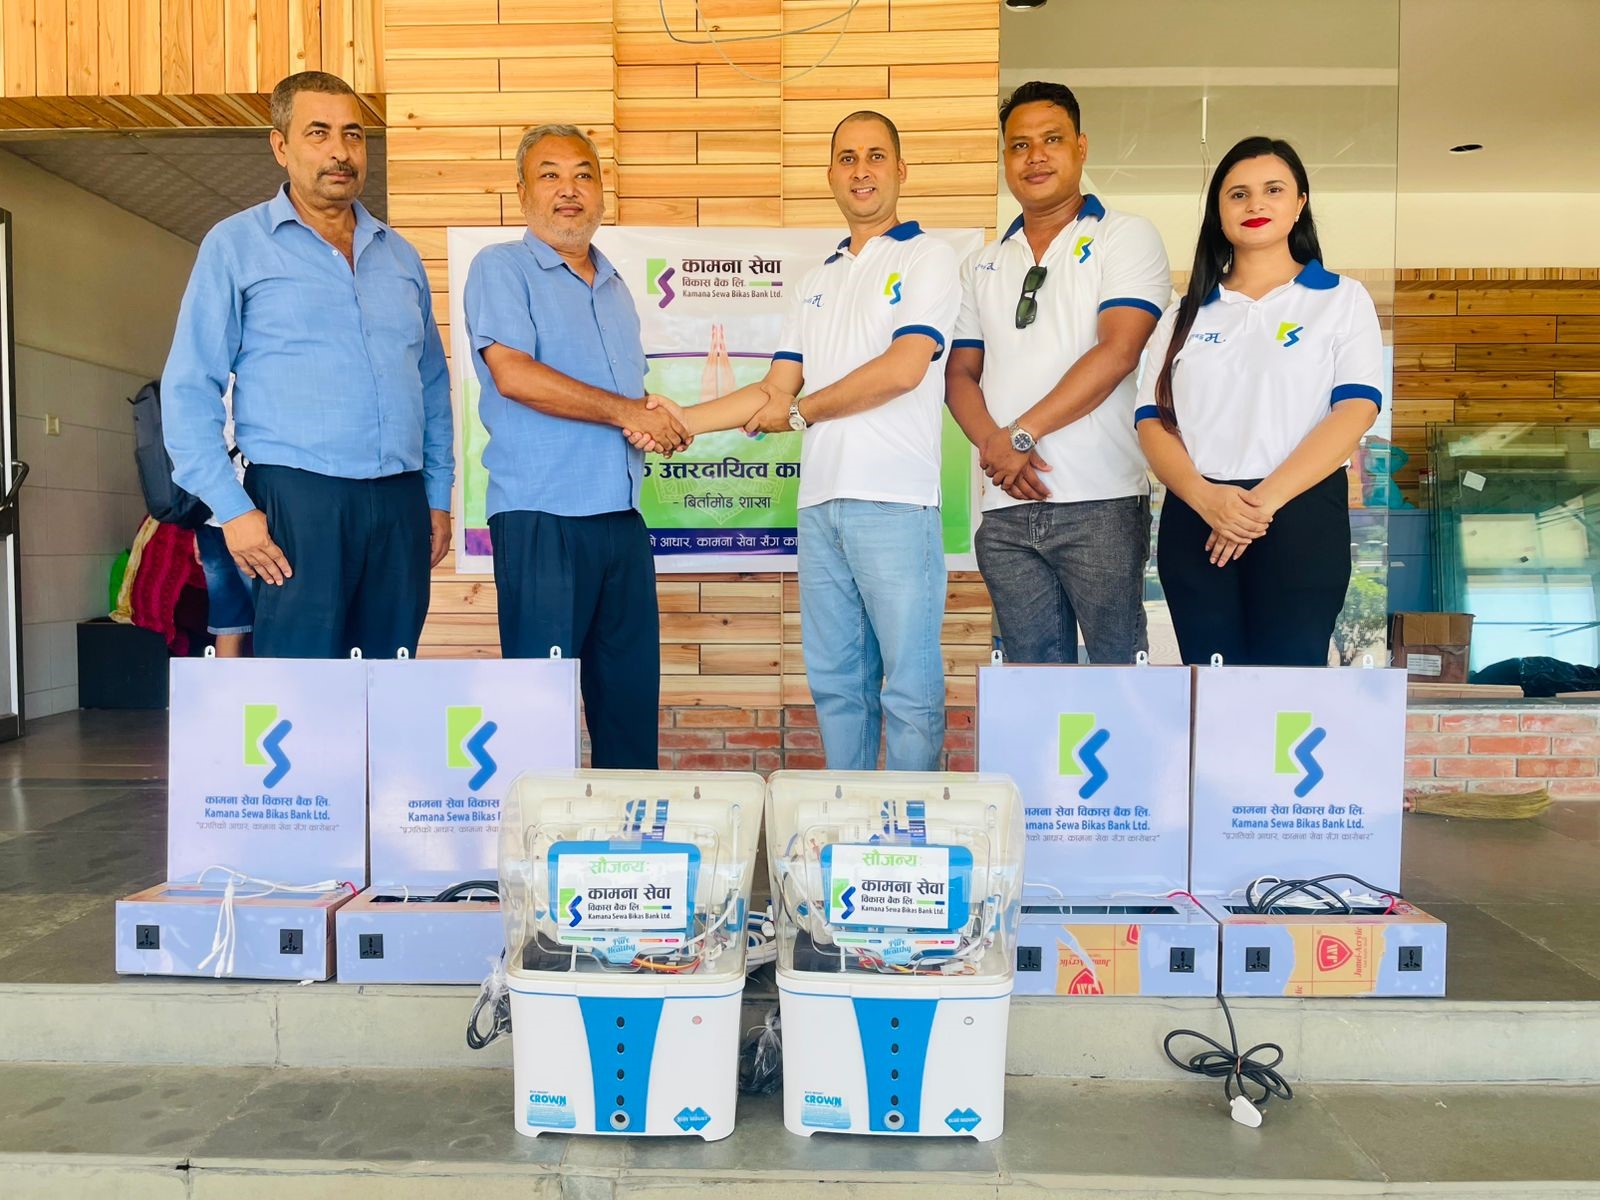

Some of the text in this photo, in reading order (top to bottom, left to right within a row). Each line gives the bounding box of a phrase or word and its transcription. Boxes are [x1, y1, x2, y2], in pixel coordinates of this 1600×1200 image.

[682, 255, 783, 275] कामना सेवा
[682, 276, 712, 288] विकास
[682, 289, 783, 298] Kamana Sewa Bikas Bank Ltd.
[659, 457, 769, 479] उत्तरदायित्व
[738, 495, 771, 509] शाखा
[696, 536, 733, 547] कामना
[737, 533, 756, 547] सेवा
[205, 795, 238, 806] कामना
[241, 794, 259, 806] सेवा
[262, 794, 293, 806] विकास
[408, 799, 442, 809] कामना
[446, 797, 464, 809] सेवा
[205, 808, 331, 821] Kamana Sewa Bikas Bank Ltd.
[1055, 805, 1074, 816] सेवा
[1078, 805, 1110, 817] विकास
[1232, 805, 1267, 815] कामना
[1270, 804, 1289, 815] सेवा
[1292, 803, 1325, 816] विकास
[408, 812, 445, 822] Kamana
[446, 811, 470, 822] Sewa
[472, 811, 496, 822] Bikas
[1025, 820, 1151, 831] mana Sewa Bikas Bank Ltd.
[1232, 818, 1364, 829] Kamana Sewa Bikas Bank Ltd.
[588, 883, 672, 900] कामना सेवा
[861, 878, 945, 895] कामना सेवा
[612, 912, 627, 920] Sewa
[628, 912, 645, 920] Bikas
[645, 912, 659, 920] Bank
[660, 912, 671, 920] Ltd.
[902, 906, 917, 914] Bikas
[530, 1094, 567, 1105] CROWN
[804, 1095, 842, 1106] CROWN
